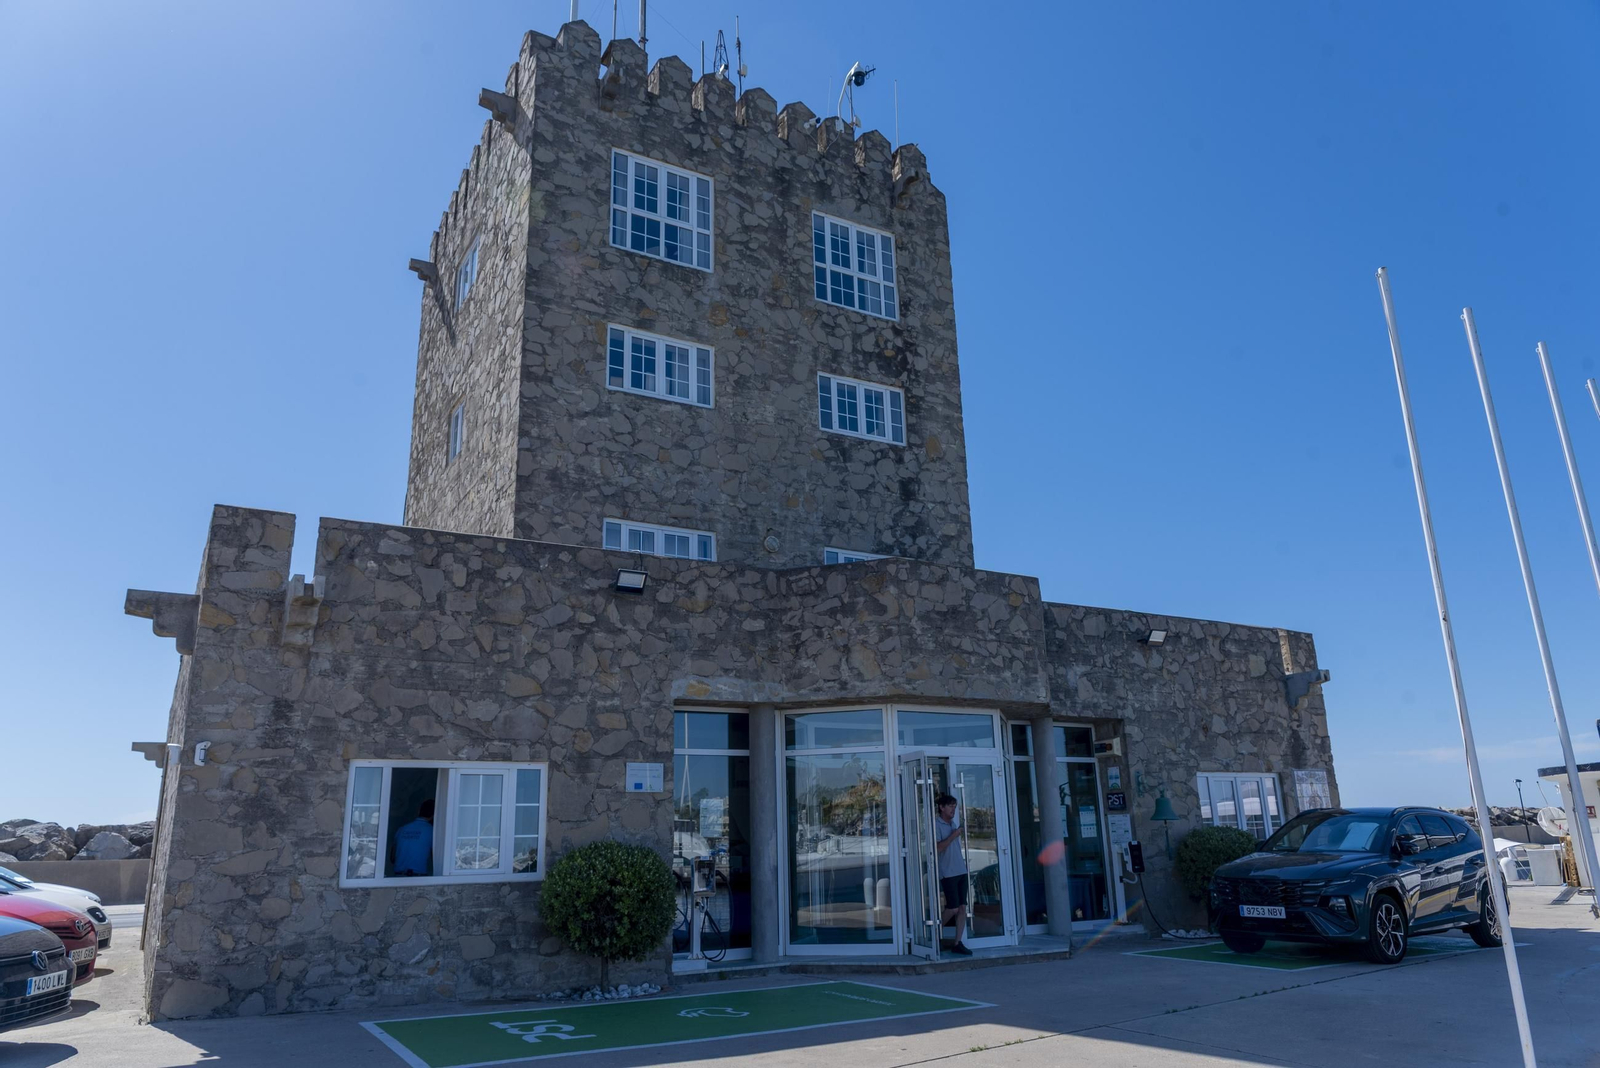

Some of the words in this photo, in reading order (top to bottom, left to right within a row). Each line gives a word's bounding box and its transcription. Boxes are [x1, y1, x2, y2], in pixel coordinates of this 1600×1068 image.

[1107, 794, 1124, 805] PST
[1246, 907, 1265, 916] 9753
[1267, 908, 1283, 916] NBV
[34, 976, 51, 992] 1400
